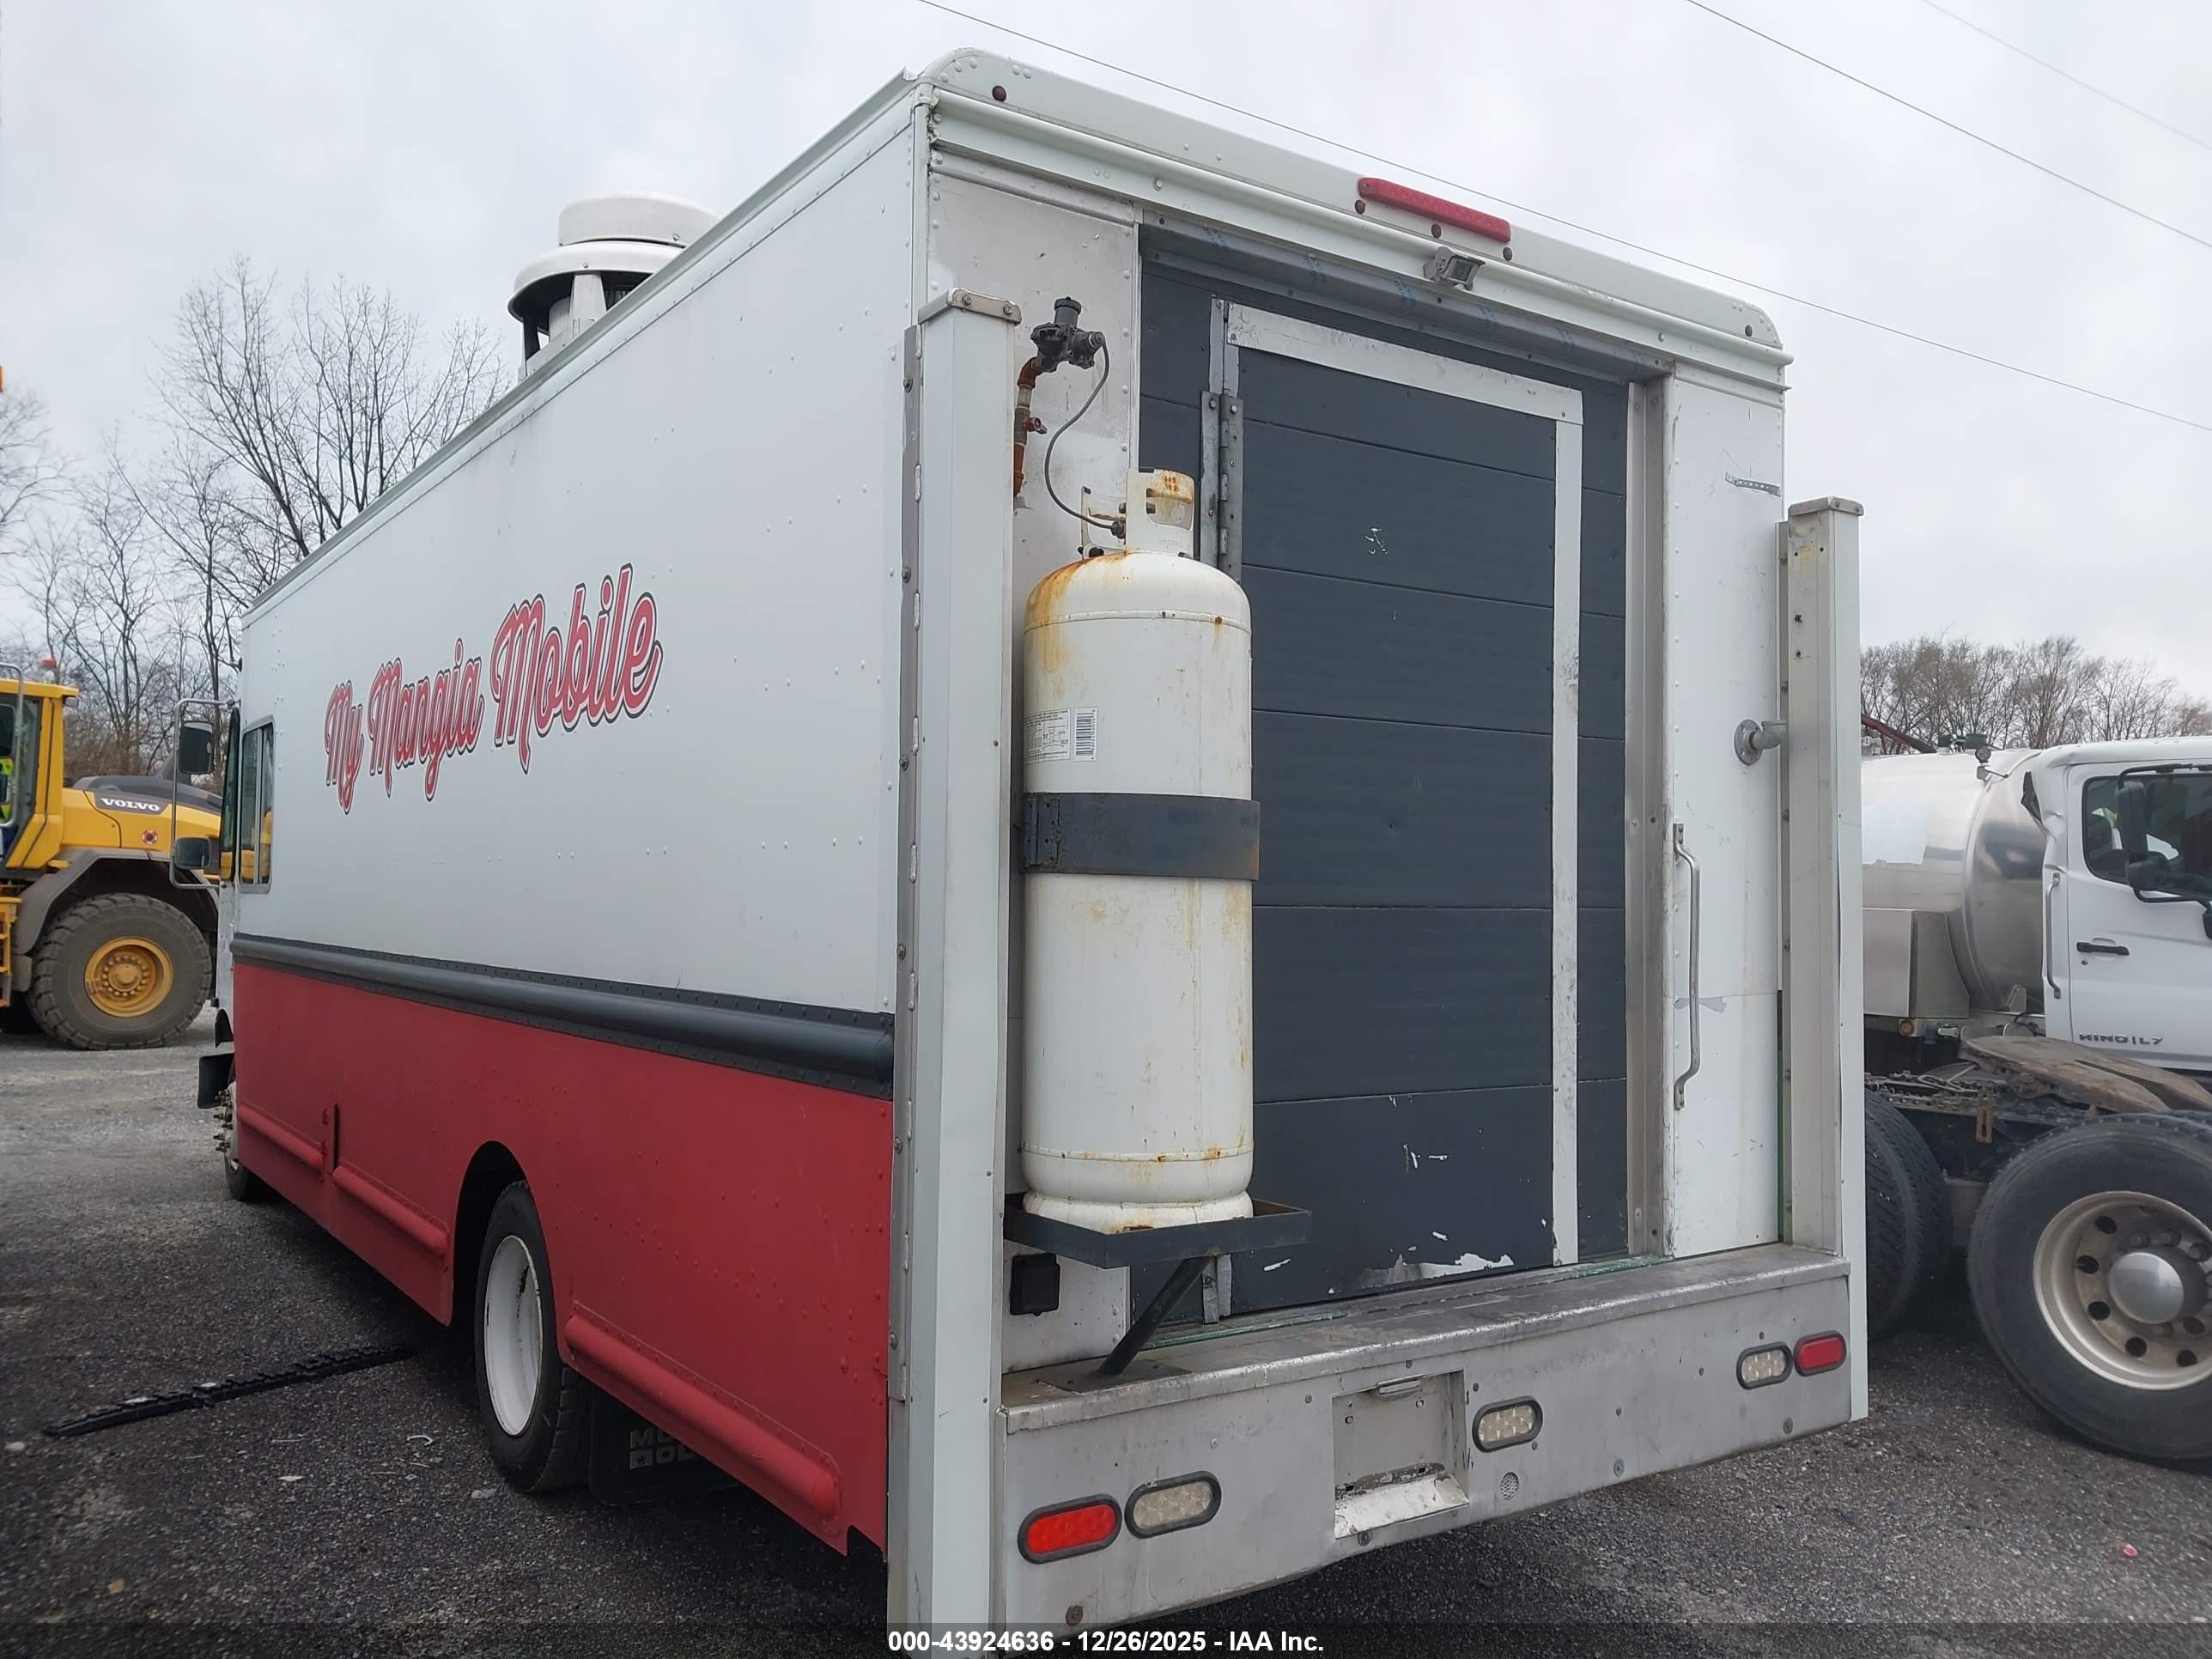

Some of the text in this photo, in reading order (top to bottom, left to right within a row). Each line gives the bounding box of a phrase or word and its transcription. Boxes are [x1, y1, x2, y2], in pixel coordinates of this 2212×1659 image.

[325, 563, 663, 814] My Mangia Mobile
[100, 797, 160, 811] VOLVO
